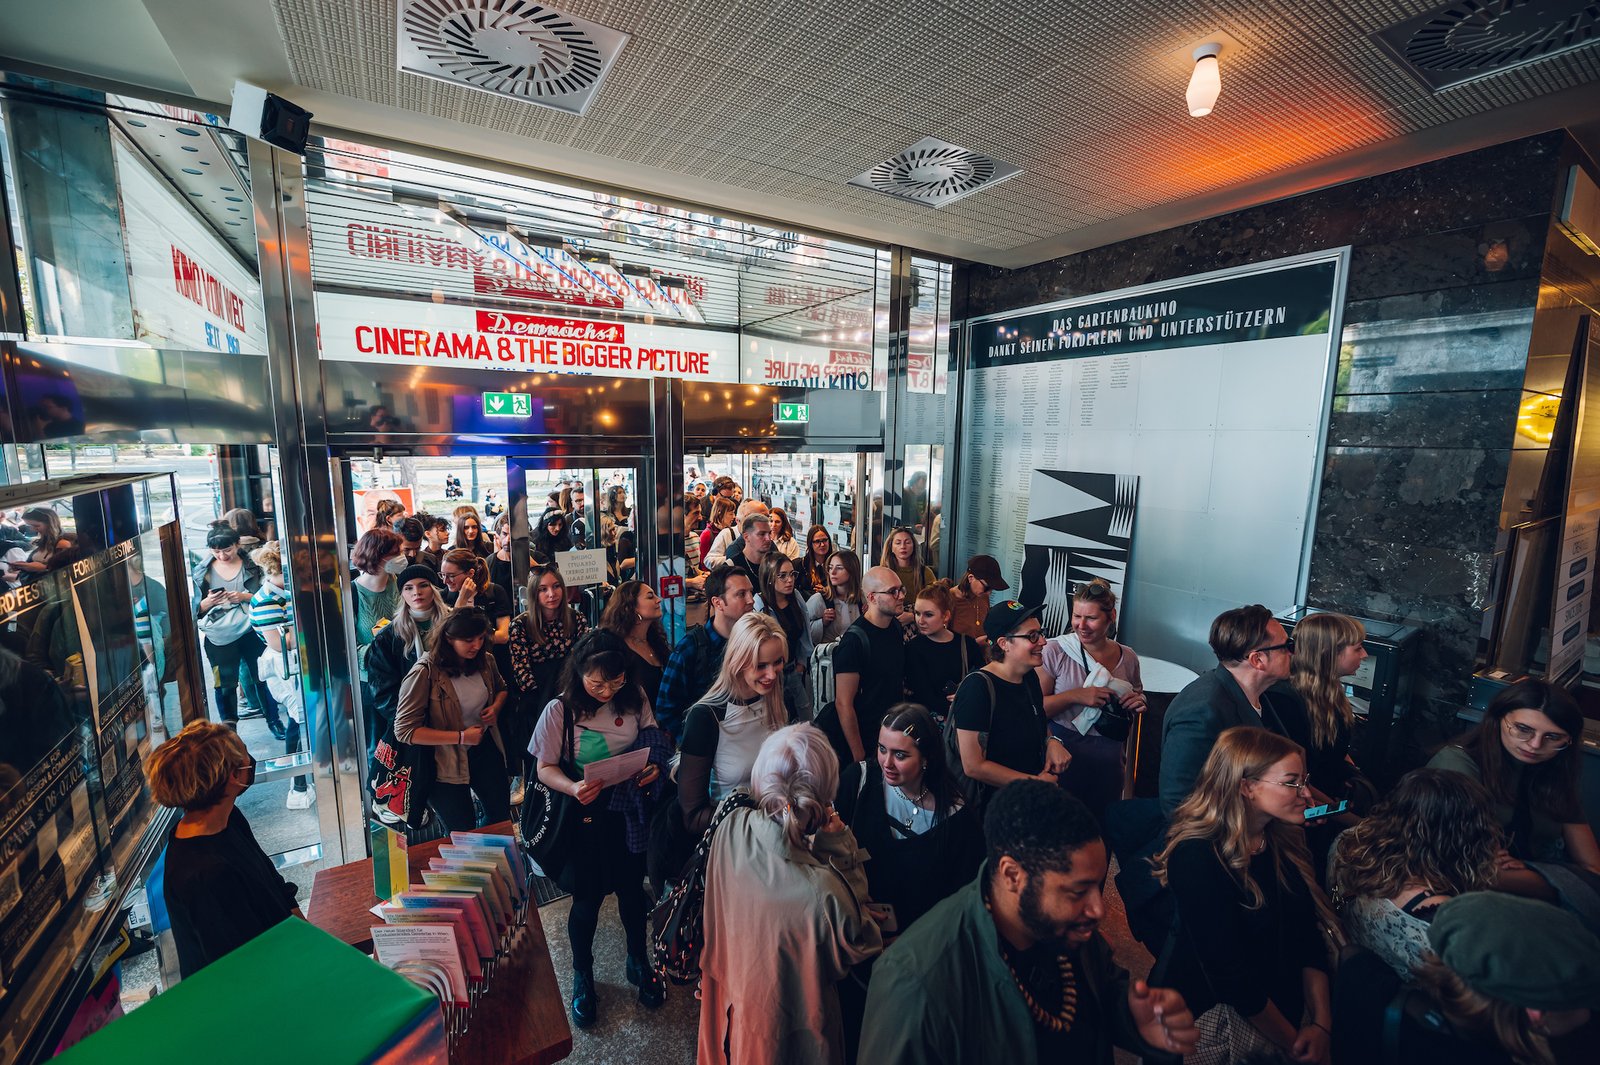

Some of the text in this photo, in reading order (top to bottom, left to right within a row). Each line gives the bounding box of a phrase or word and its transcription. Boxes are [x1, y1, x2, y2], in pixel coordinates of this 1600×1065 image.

[487, 311, 618, 342] Demnächst
[988, 306, 1287, 358] DANKT SEINEN FÖRDERERN UND UNTERSTÜTZERN
[1052, 299, 1177, 333] DAS GARTENBAUKINO
[355, 325, 710, 374] CINERAMA & THE BIGGER PICTURE
[530, 824, 547, 847] MORE
